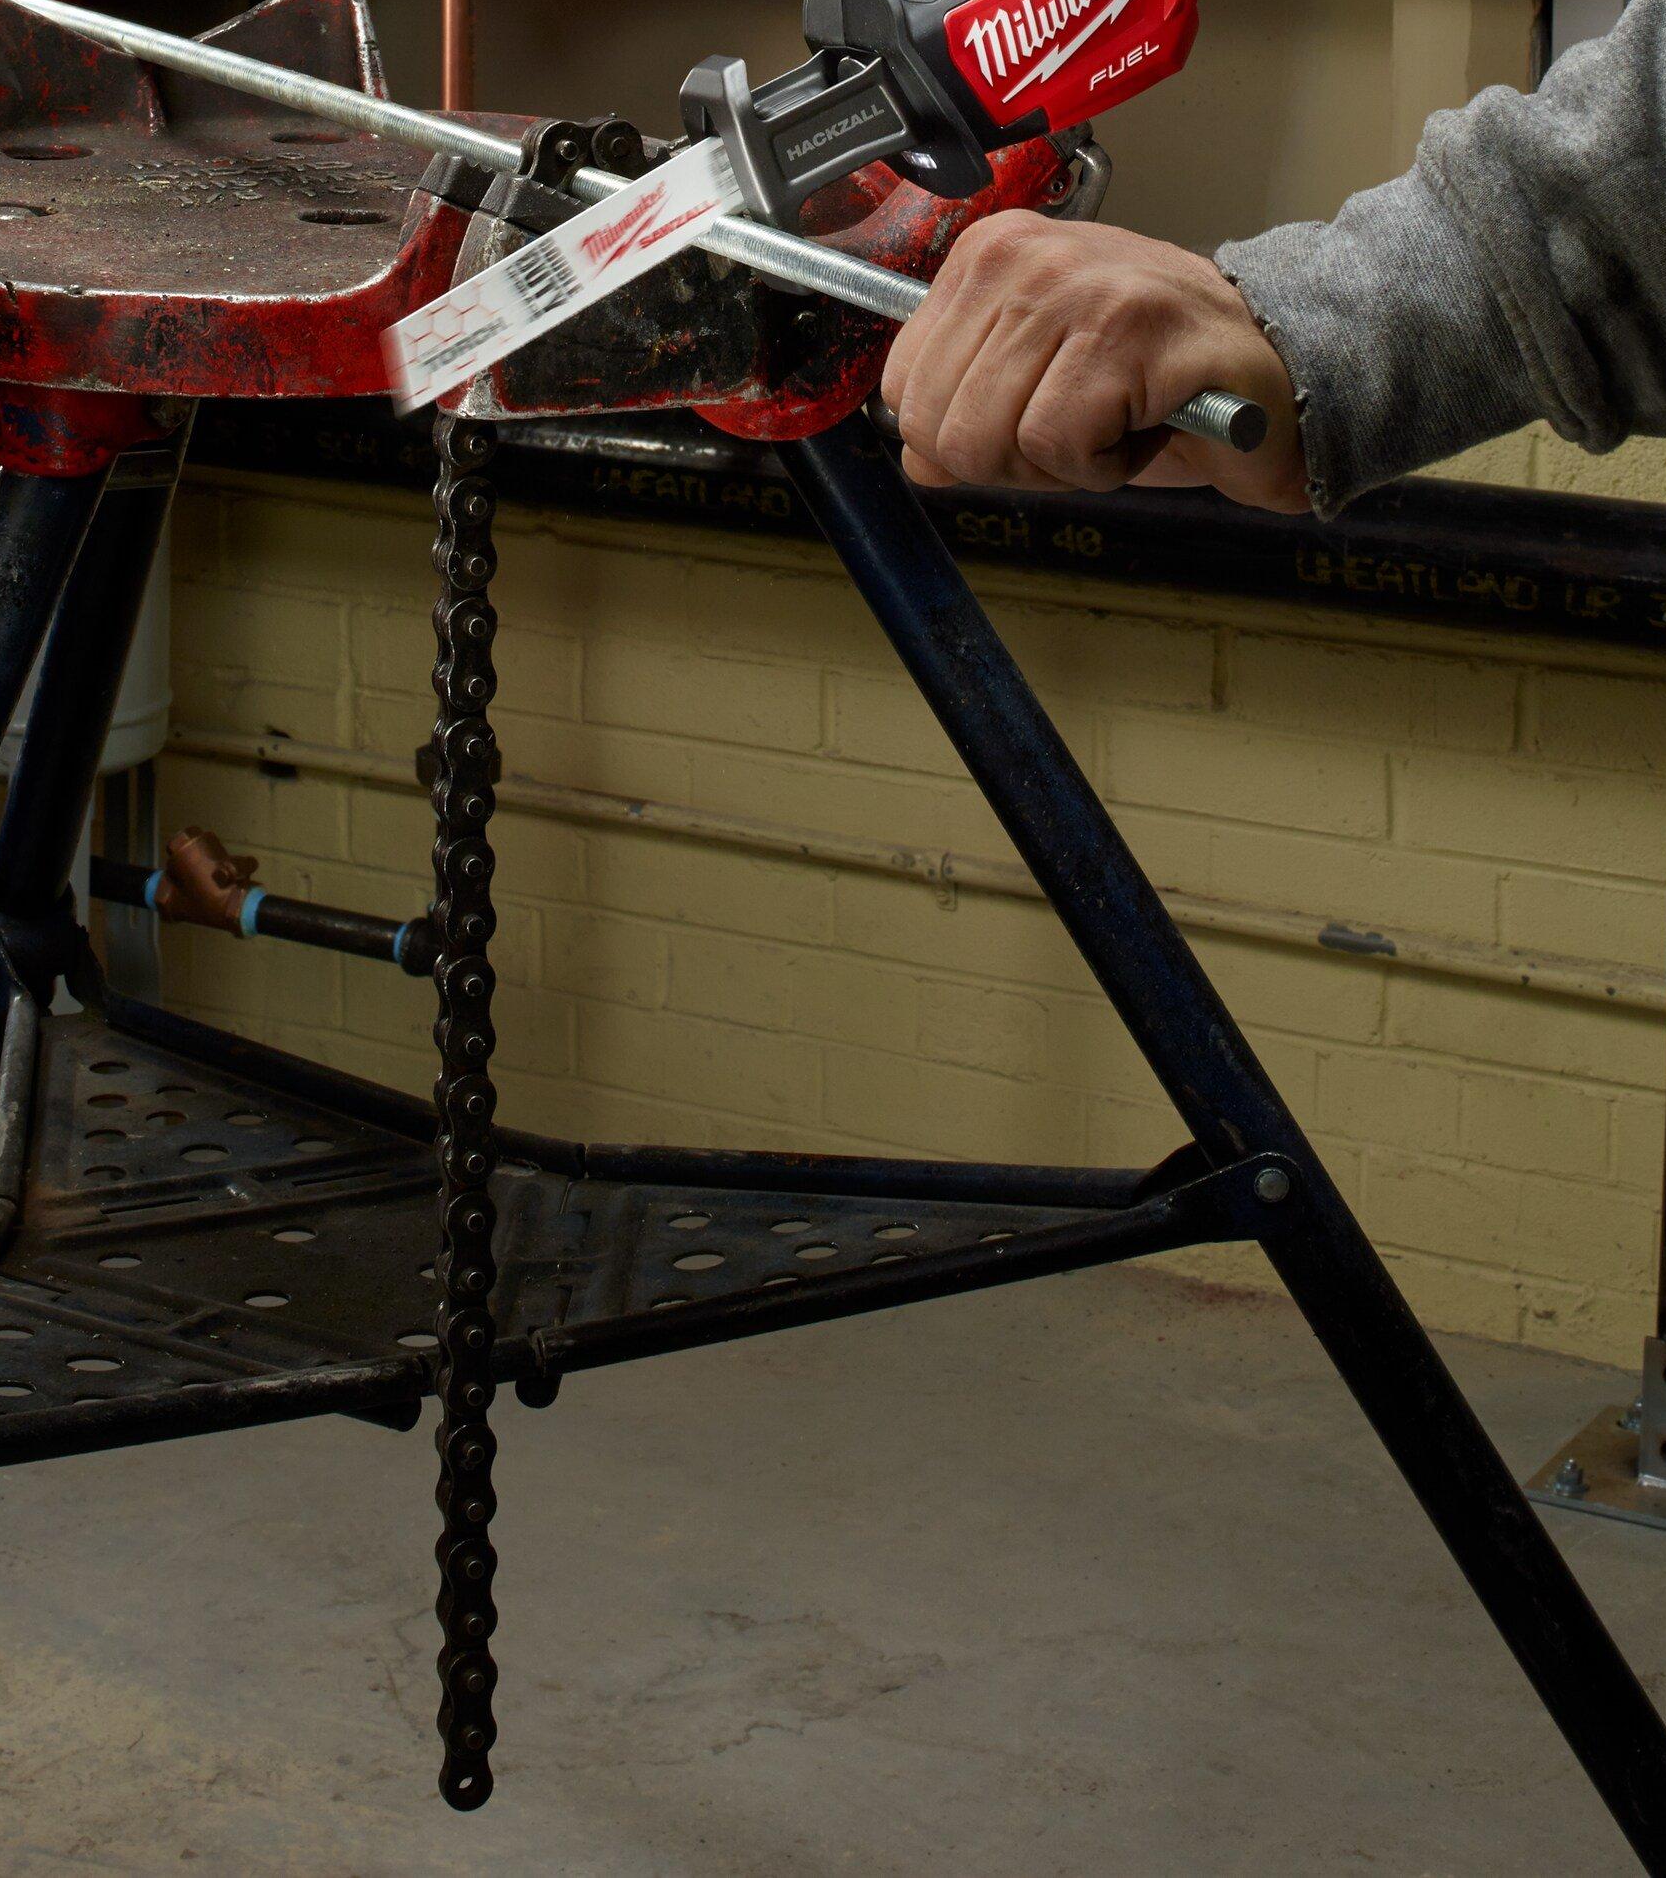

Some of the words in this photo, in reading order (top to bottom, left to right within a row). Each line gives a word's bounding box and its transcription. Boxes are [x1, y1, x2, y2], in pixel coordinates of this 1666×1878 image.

[1088, 41, 1160, 92] FUEL
[785, 103, 885, 162] HACKZALL
[955, 509, 1030, 549] SCH
